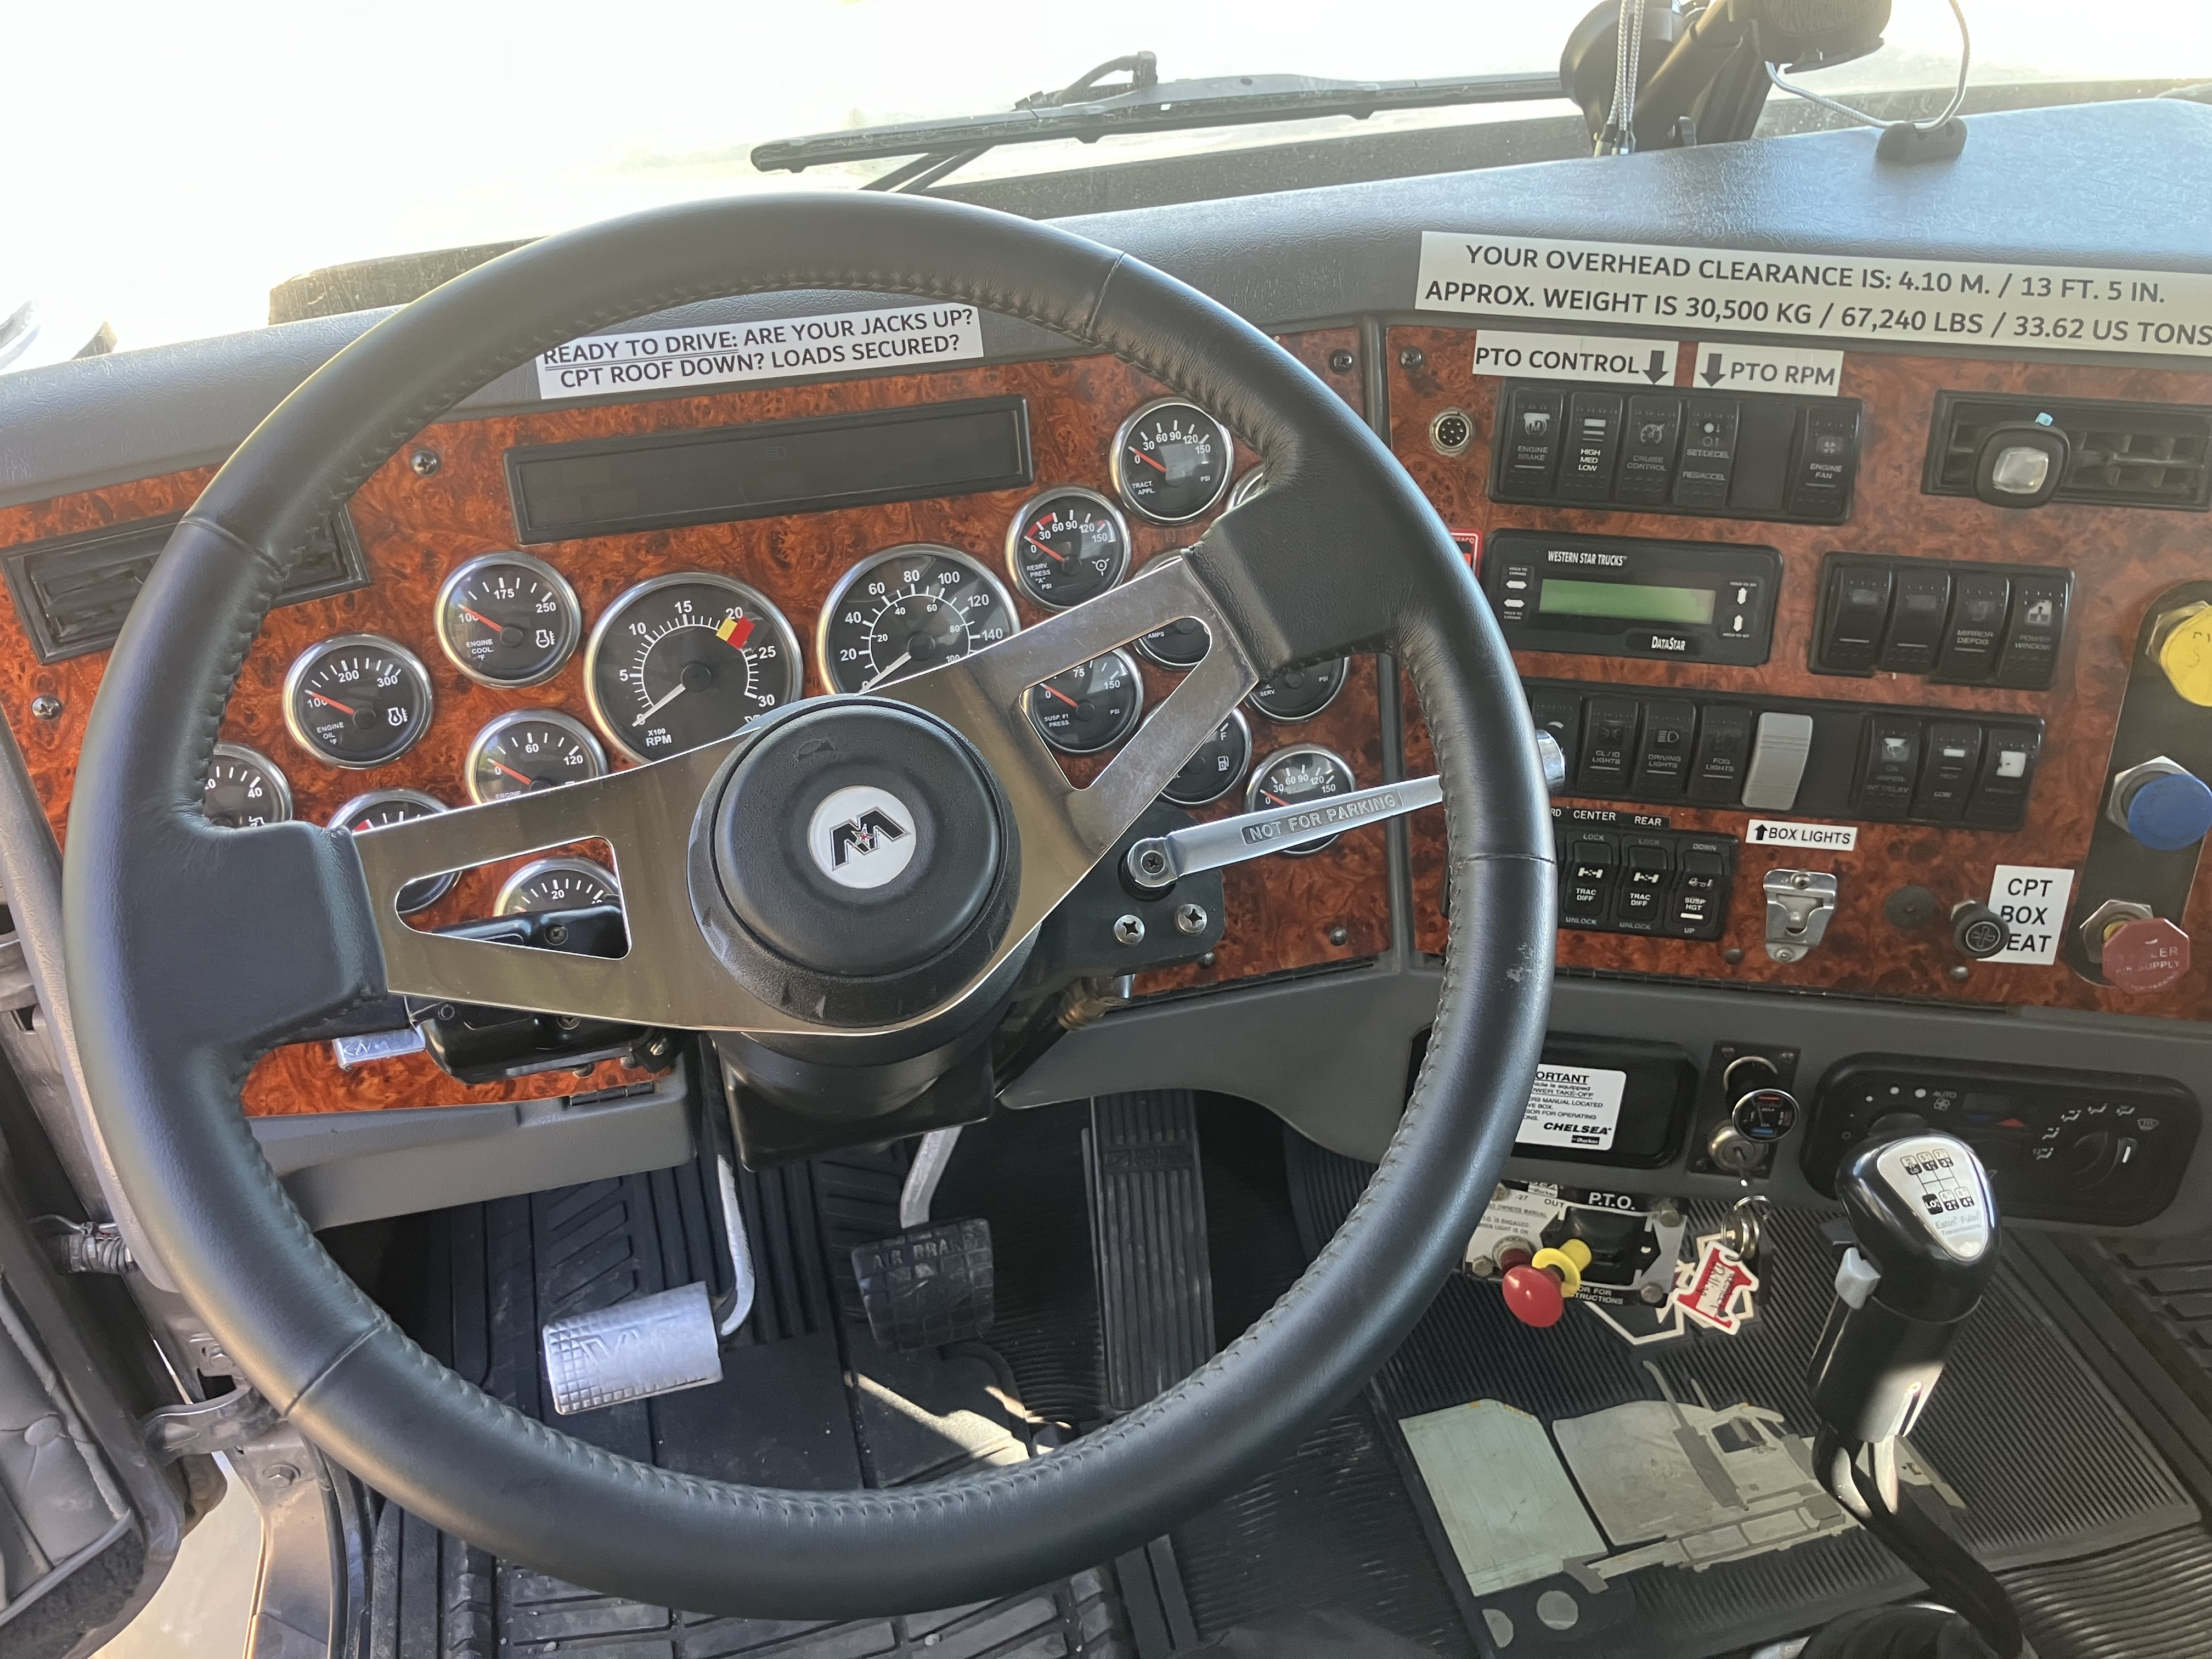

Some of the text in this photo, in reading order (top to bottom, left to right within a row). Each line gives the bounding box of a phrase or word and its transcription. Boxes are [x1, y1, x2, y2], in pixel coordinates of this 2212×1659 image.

[1465, 245, 2165, 303] YOUR OVERHEAD CLEARANCE IS: 4.10 M. / 13 FT. 5 IN.
[1425, 280, 2212, 346] APPROX. WEIGHT IS 30,500 KG / 67,240 LBS / 33.62 US TONS
[543, 308, 973, 365] READY TO DRIVE: ARE YOUR JACKS UP?
[560, 335, 960, 388] CPT ROOF DOWN? LOADS SECURED?
[1476, 347, 1639, 375] PTO CONTROL
[1730, 362, 1836, 386] PTO RPM
[1135, 431, 1211, 464] 0 30 60 90 120 150
[1517, 445, 1548, 455] ENGINE
[1581, 448, 1601, 456] HIGH
[1517, 453, 1545, 461] BRAKE
[1580, 456, 1598, 464] MED
[1633, 455, 1664, 464] CRUISE
[1578, 464, 1598, 472] LOW
[1627, 462, 1666, 472] CONTROL
[1809, 464, 1842, 473] ENGINE
[1815, 471, 1833, 479] FAN
[1030, 520, 1108, 553] 0 30 60 90 120 150
[1548, 550, 1579, 563] WESTERN
[1579, 552, 1597, 565] STAR
[494, 588, 556, 613] 175 250
[840, 569, 1003, 662] 20 40 60 80 100 120 140
[877, 603, 960, 642] 20 40 60 80
[466, 639, 493, 648] ENGINE
[619, 600, 776, 708] 5 10 15 20 25 30
[338, 670, 398, 687] 200 300
[1045, 669, 1120, 699] 0 75 150
[317, 722, 345, 733] ENGINE
[648, 727, 666, 736] X100
[646, 734, 672, 747] RPM
[494, 743, 583, 775] 0 60 120
[1592, 757, 1621, 765] LIGHTS
[1648, 754, 1681, 763] DRIVING
[1705, 764, 1734, 772] LIGHTS
[1273, 774, 1336, 793] 30 60 90 120 150
[248, 787, 263, 799] 40
[1249, 794, 1396, 840] NOT FOR PARKING
[1573, 810, 1616, 822] CENTER
[1634, 816, 1662, 827] REAR
[1769, 827, 1851, 844] BOX LIGHTS
[1638, 838, 1660, 846] LOCK
[1692, 843, 1717, 851] DOWN
[1576, 888, 1596, 896] TRAC
[2008, 878, 2053, 897] CPT
[551, 889, 565, 899] 20
[1577, 894, 1594, 902] DIFF
[1630, 893, 1651, 901] TRAC
[1630, 899, 1648, 907] DIFF
[1684, 896, 1706, 905] SUSP
[1685, 903, 1703, 912] HGT
[2001, 905, 2049, 926] BOX
[1565, 917, 1597, 926] UNLOCK
[1620, 921, 1651, 930] UNLOCK
[2006, 933, 2052, 953] EAT
[1536, 1071, 1589, 1084] ORTANT
[1555, 1089, 1594, 1098] TAKE-OFF
[1558, 1111, 1596, 1120] OPERATING
[1544, 1122, 1608, 1135] CHELSEA
[1544, 1198, 1564, 1208] OUT
[1589, 1192, 1635, 1210] P.T.O.
[1523, 1207, 1547, 1218] MANUAL
[1593, 1288, 1612, 1296] FOR
